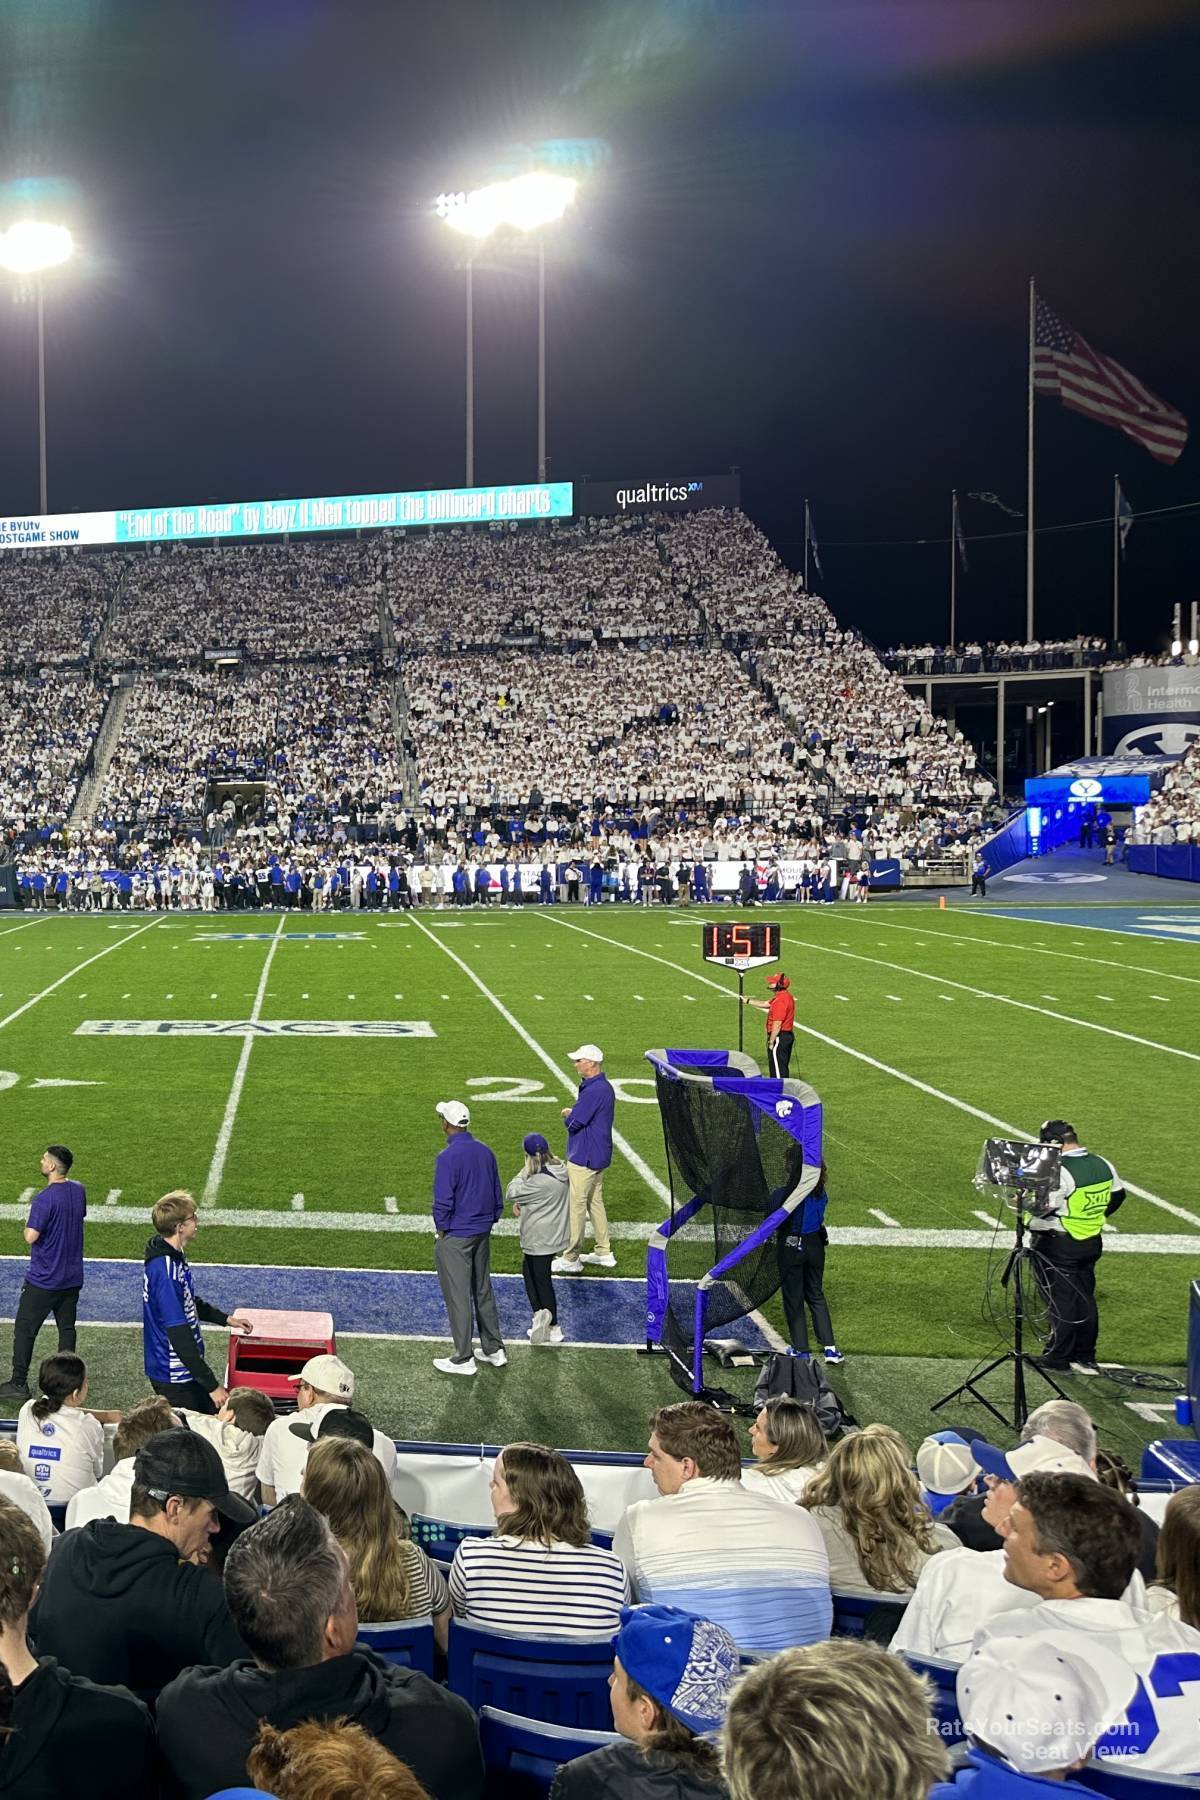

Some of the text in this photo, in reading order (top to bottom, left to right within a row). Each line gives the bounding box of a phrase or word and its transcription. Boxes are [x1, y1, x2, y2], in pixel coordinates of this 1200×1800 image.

[616, 483, 688, 510] qualtrics
[154, 511, 170, 536] of
[172, 509, 194, 535] the
[244, 504, 261, 534] by
[264, 502, 297, 533] Boyz
[312, 498, 343, 526] Men
[346, 496, 397, 525] topped
[400, 493, 425, 520] the
[427, 489, 495, 519] billboard
[498, 487, 551, 515] charts
[10, 520, 41, 532] BYUtv
[49, 529, 80, 541] SHOW
[1147, 699, 1192, 710] Health
[712, 925, 772, 958] 1:51
[156, 1022, 414, 1034] PACS
[31, 1447, 57, 1458] qualtrics
